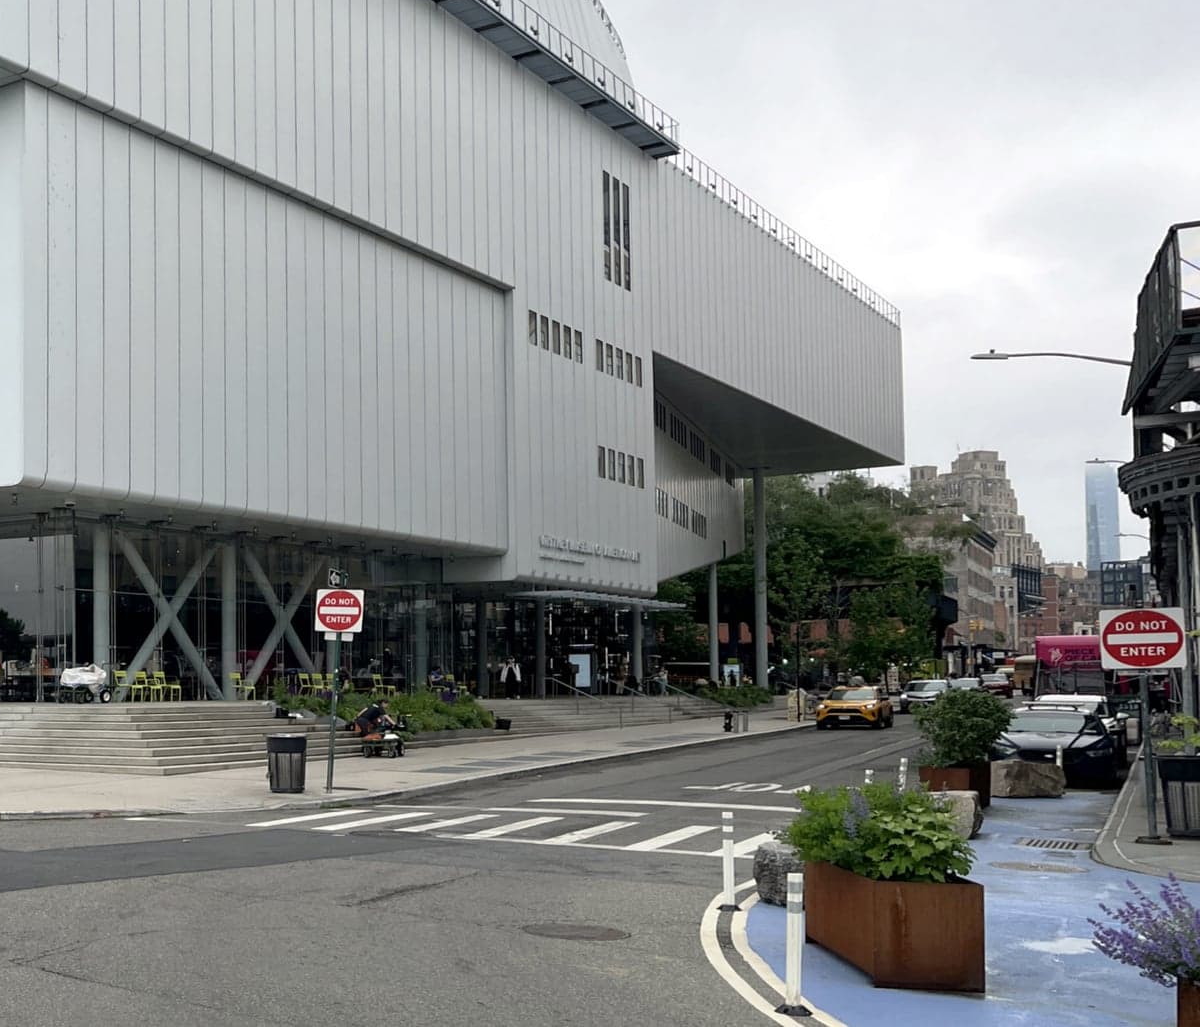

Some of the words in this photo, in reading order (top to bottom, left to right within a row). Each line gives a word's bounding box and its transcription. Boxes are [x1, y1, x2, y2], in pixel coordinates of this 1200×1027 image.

[1115, 622, 1134, 631] DO
[1140, 620, 1167, 631] NOT
[1120, 646, 1166, 657] ENTER
